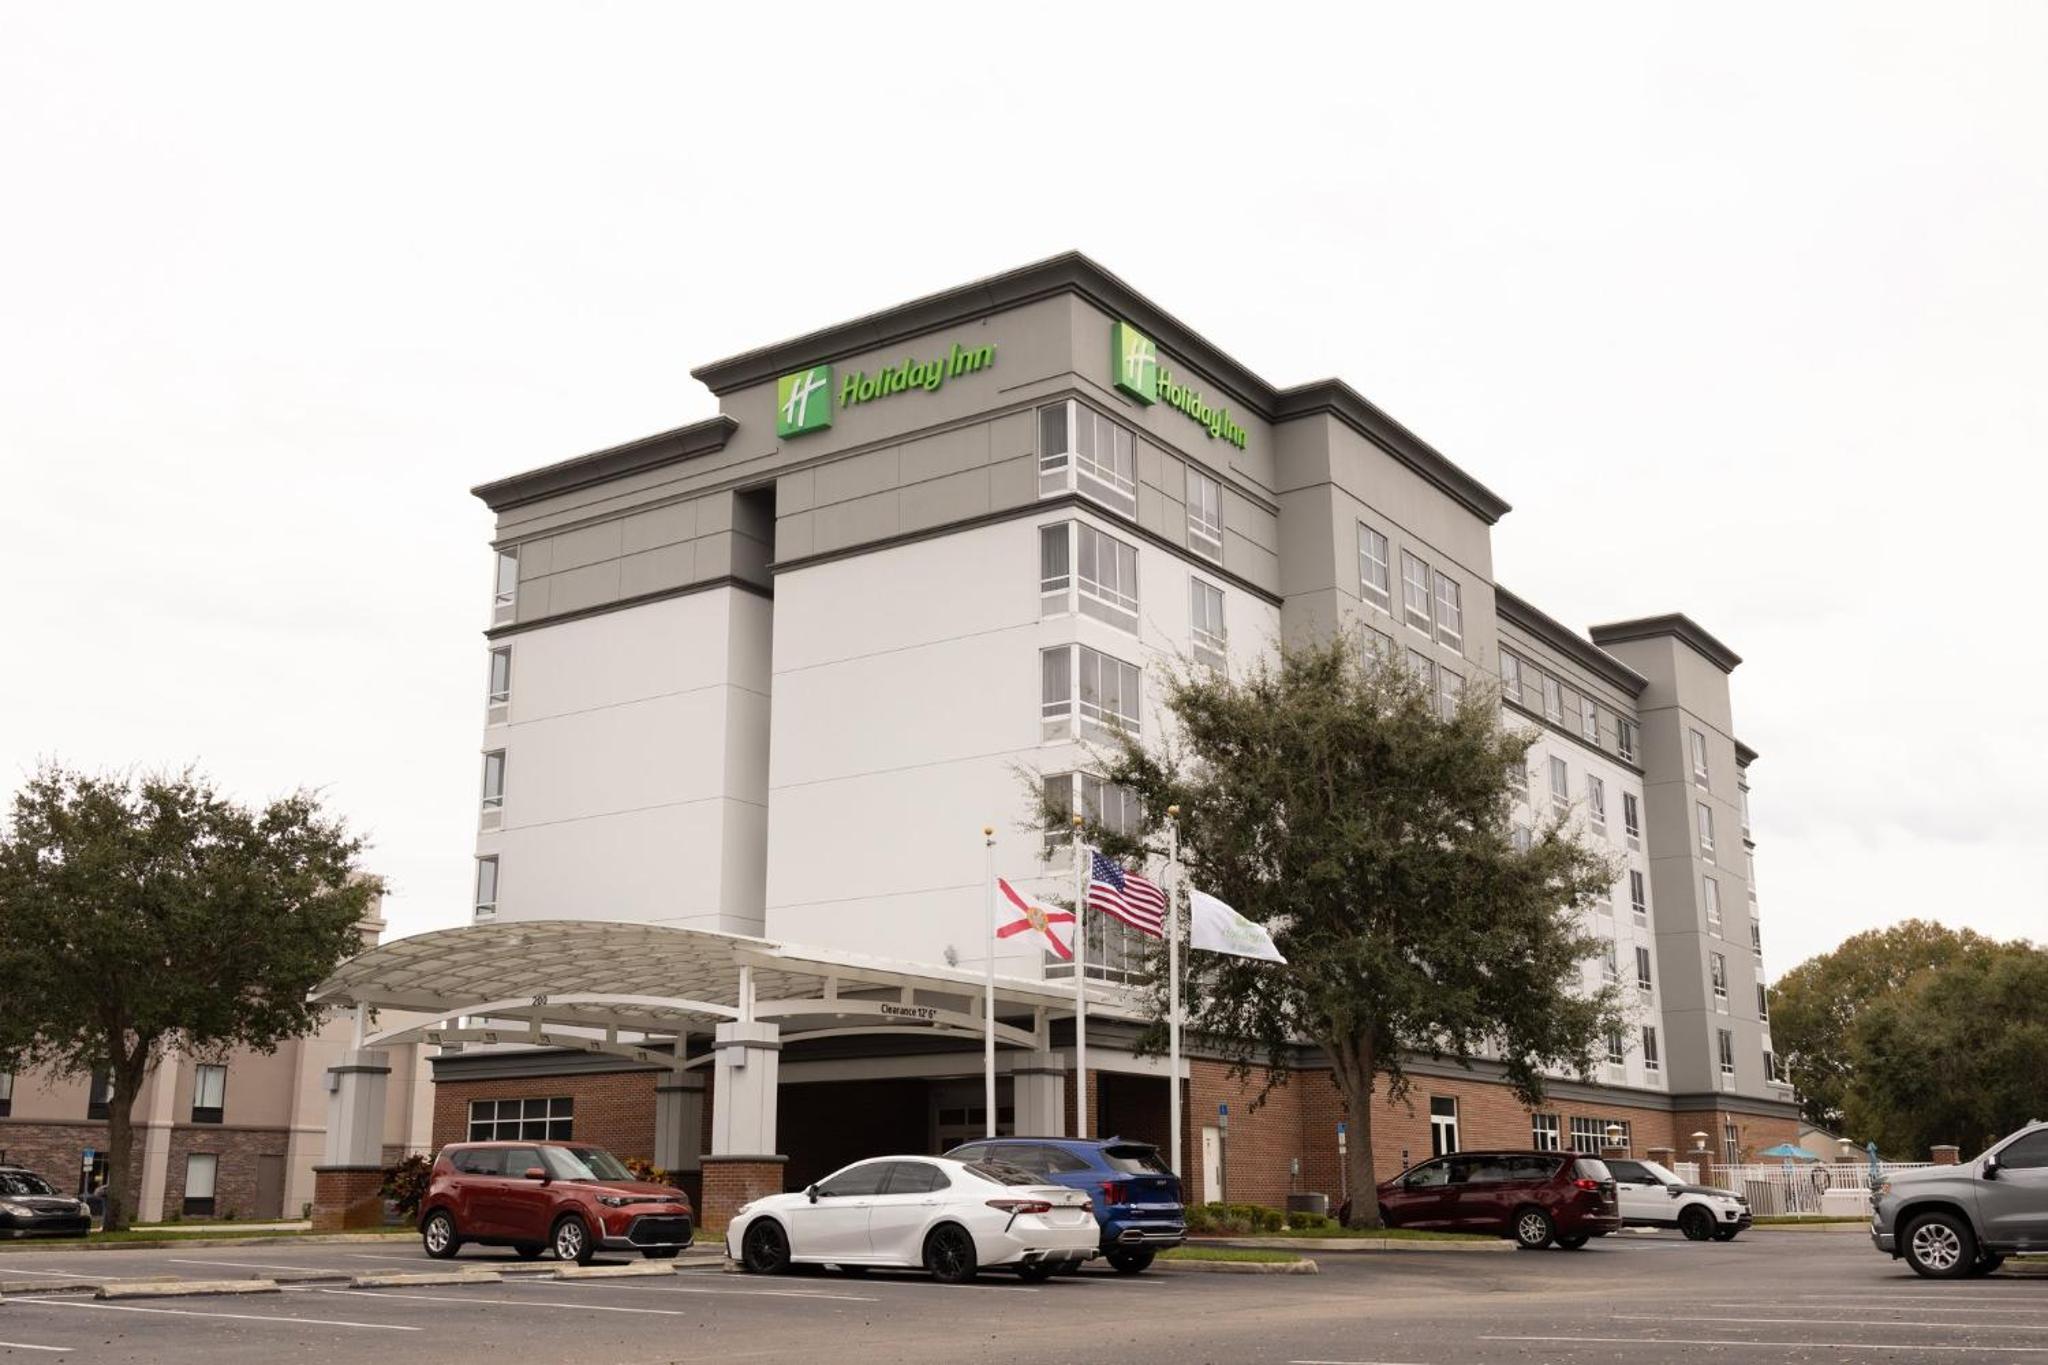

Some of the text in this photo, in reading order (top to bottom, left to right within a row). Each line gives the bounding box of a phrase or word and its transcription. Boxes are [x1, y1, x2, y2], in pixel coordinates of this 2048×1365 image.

[839, 342, 994, 409] Holiday Inn
[1156, 366, 1246, 449] Holiday Inn
[881, 1004, 917, 1016] Clearance
